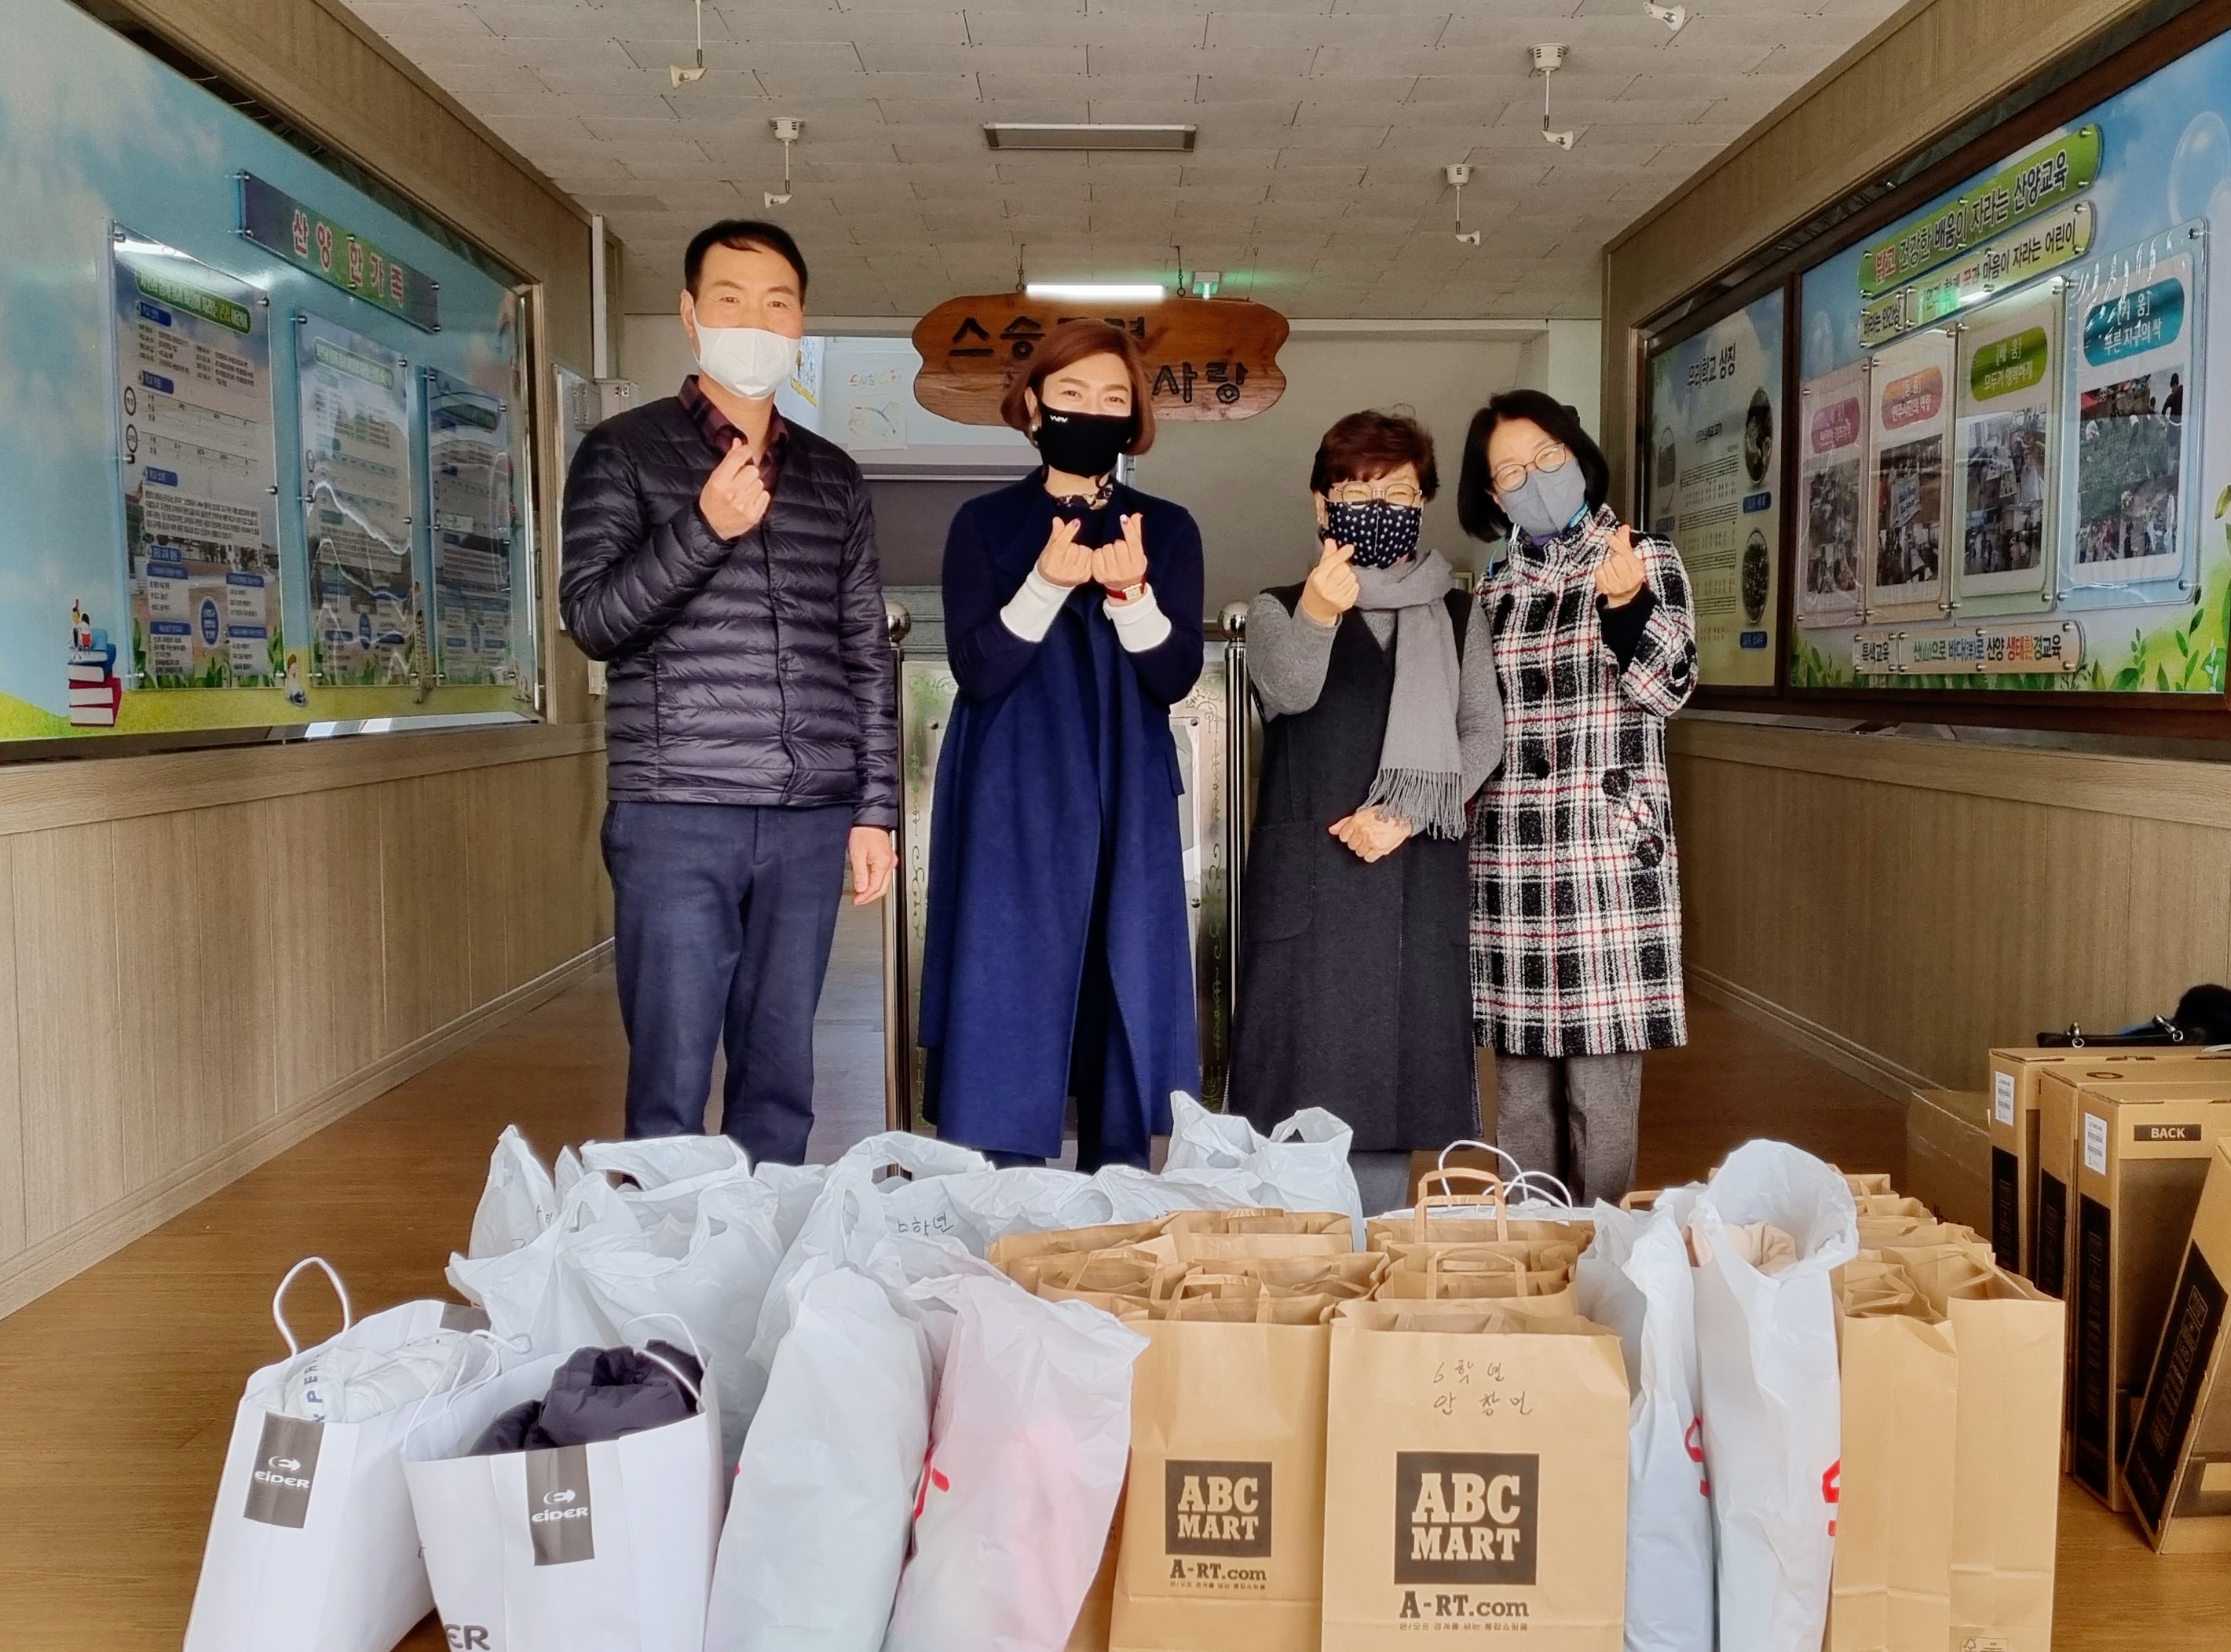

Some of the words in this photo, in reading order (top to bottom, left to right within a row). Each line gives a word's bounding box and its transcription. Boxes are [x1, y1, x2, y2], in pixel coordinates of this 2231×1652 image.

[1875, 245, 1896, 283] 밝고
[1899, 225, 1932, 272] 건강한
[1934, 206, 1968, 250] 배움이
[1970, 188, 2009, 232] 자라는
[2013, 149, 2068, 214] 산양교육
[292, 209, 333, 272] 산양
[1983, 252, 2010, 280] 마음이
[2012, 237, 2042, 268] 자라는
[2045, 218, 2076, 254] 어린이
[949, 316, 1046, 360] 스승
[1150, 361, 1249, 404] 사랑
[1688, 356, 1717, 393] 우리학교
[1718, 342, 1736, 379] 상징
[1986, 635, 2005, 661] 산양
[2151, 1128, 2185, 1138] BACK
[1177, 1475, 1258, 1513] ABC
[1411, 1472, 1520, 1523] ABC
[1177, 1514, 1259, 1540] MART
[1411, 1527, 1520, 1561] MART
[1169, 1559, 1267, 1581] A-RT.com
[1399, 1591, 1530, 1618] A-RT.com
